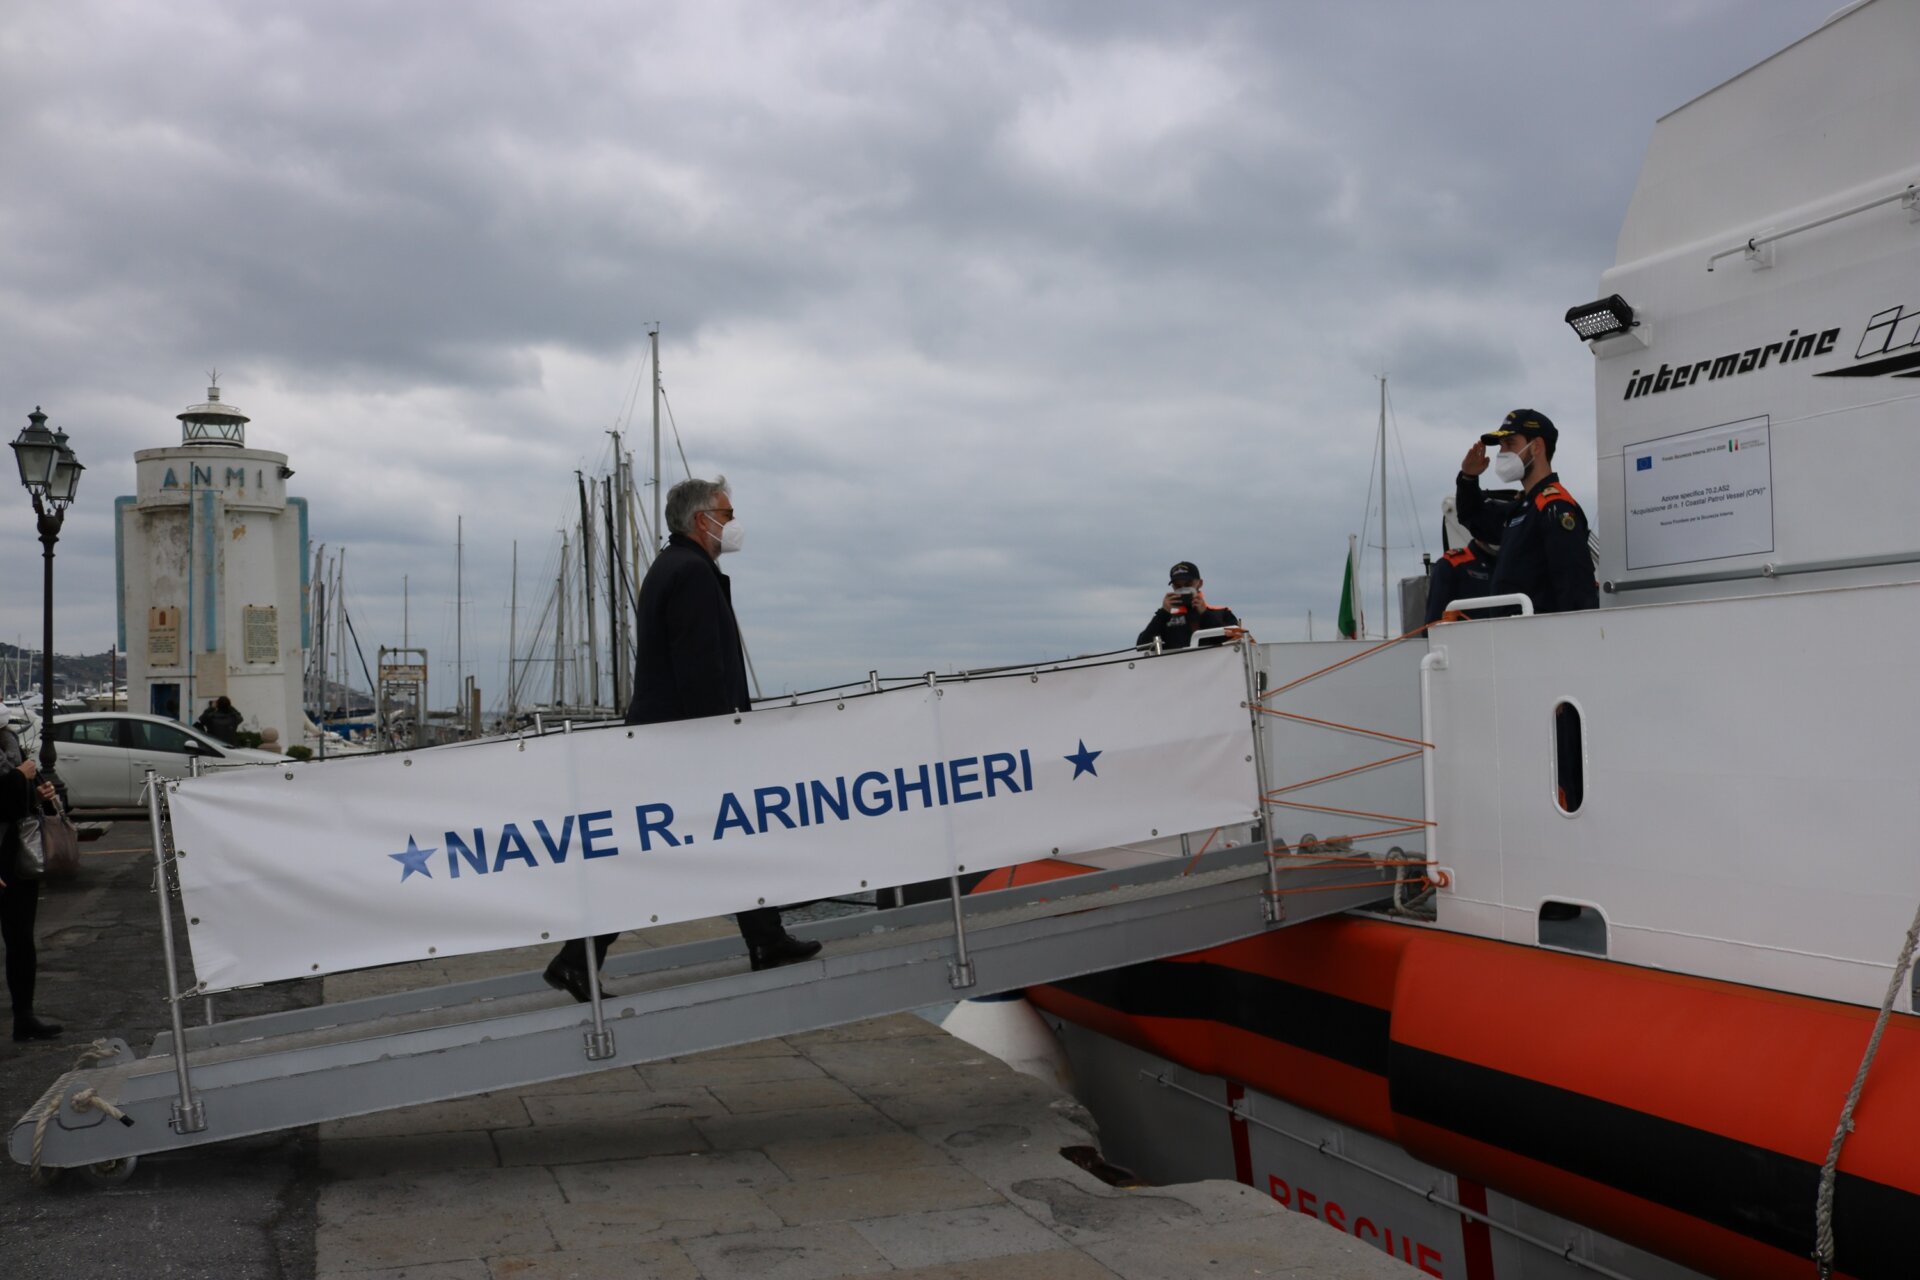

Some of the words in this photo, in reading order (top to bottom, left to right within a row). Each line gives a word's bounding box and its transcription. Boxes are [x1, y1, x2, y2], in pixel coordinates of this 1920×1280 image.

[1624, 328, 1840, 400] intermarine
[1661, 495, 1679, 503] Azione
[1680, 490, 1704, 500] specifica
[1685, 498, 1707, 507] Coastal
[1708, 495, 1725, 503] Patrol
[1726, 492, 1745, 500] Vessel
[444, 810, 619, 879] NAVE
[634, 802, 694, 851] R.
[712, 748, 1034, 840] ARINGHIERI
